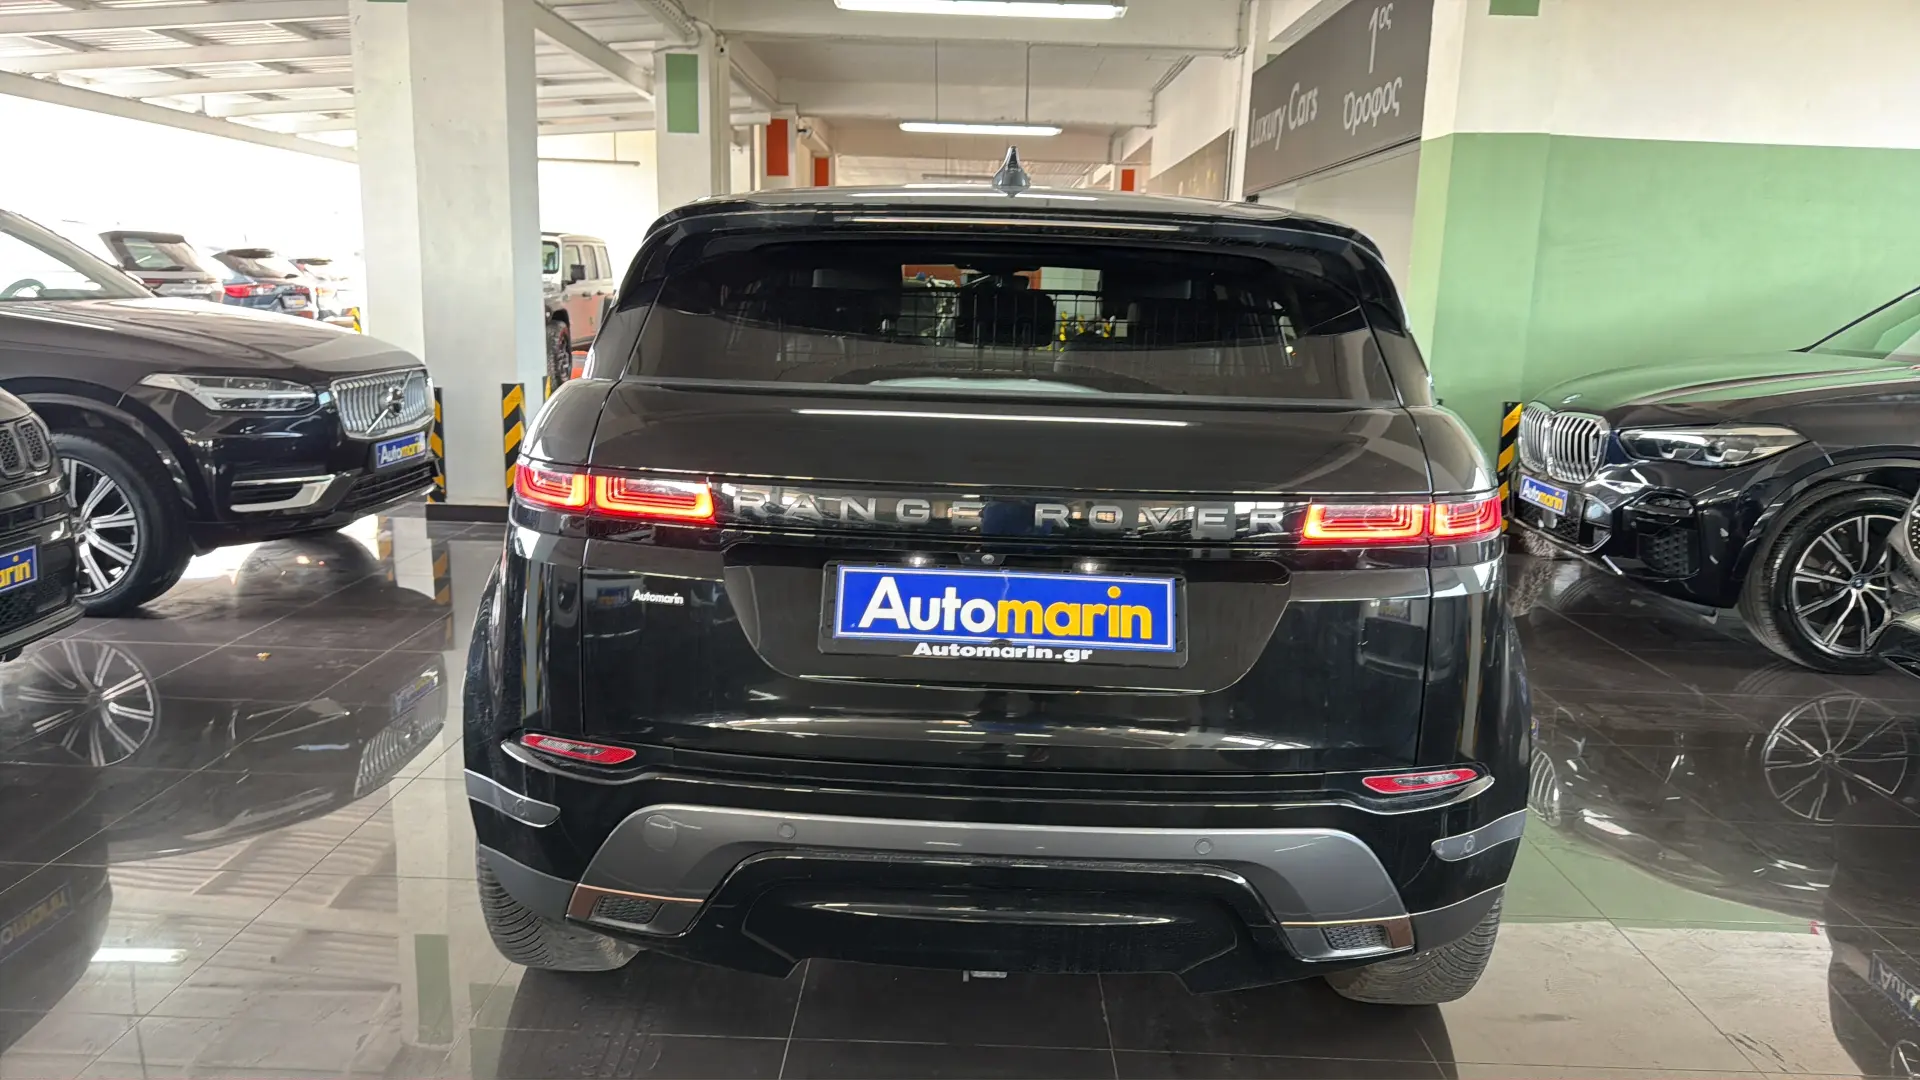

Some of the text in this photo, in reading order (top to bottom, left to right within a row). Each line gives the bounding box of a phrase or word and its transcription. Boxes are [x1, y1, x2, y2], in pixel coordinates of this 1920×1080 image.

[1250, 82, 1318, 151] Luxury Cars
[733, 491, 1285, 533] RANGE ROVER
[632, 589, 684, 605] Automarin
[858, 576, 1152, 639] Automarin
[912, 642, 1093, 662] Automarin.gr
